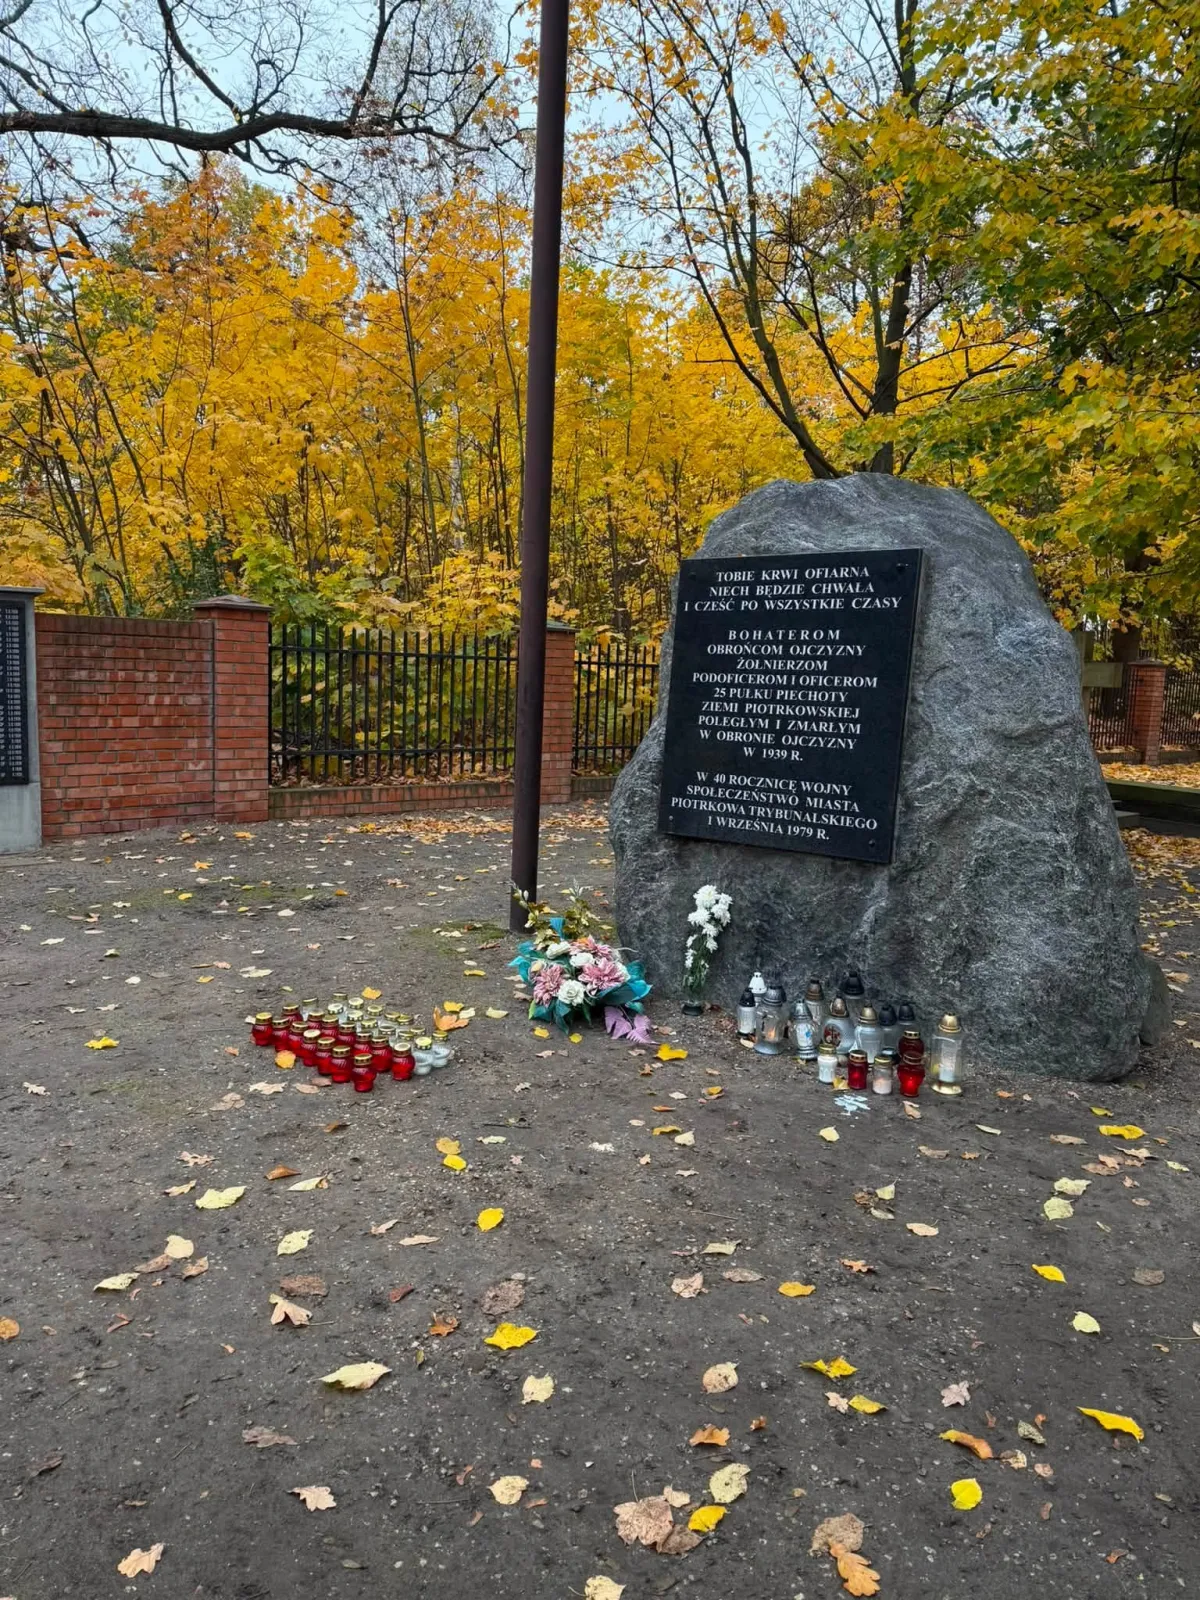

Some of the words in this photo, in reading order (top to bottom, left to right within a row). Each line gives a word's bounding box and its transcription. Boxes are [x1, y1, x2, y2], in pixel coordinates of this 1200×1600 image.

[716, 570, 755, 582] TOBIE
[761, 569, 798, 580] KRWI
[805, 566, 870, 579] OFIARNA
[709, 585, 750, 597] NIECH
[756, 584, 805, 599] BĘDZIE
[811, 582, 875, 594] CHWAŁA
[684, 602, 689, 612] I
[694, 598, 735, 611] CZEŚĆ
[741, 600, 759, 611] PO
[765, 598, 845, 610] WSZYSTKIE
[851, 597, 901, 609] CZASY
[707, 642, 783, 656] OBROŃCOM
[790, 645, 866, 656] OJCZYZNY
[736, 658, 828, 671] ŻOŁNIERZOM
[692, 673, 787, 686] PODOFICEROM
[791, 675, 796, 685] I
[800, 675, 878, 688] OFICEROM
[713, 687, 726, 698] 25
[729, 688, 773, 700] PUŁKU
[776, 690, 849, 702] PIECHOTY
[701, 701, 738, 713] ZIEMI
[745, 703, 860, 719] PIOTRKOWSKIEJ
[698, 715, 769, 729] POLEGŁYM
[775, 719, 780, 730] I
[787, 720, 861, 734] ZMARŁYM
[699, 730, 712, 740] W
[717, 730, 776, 744] OBRONIE
[781, 735, 857, 750] OJCZYZNY
[743, 747, 756, 758] W
[762, 748, 787, 760] 1939
[790, 751, 803, 762] R.
[696, 772, 709, 782] W
[713, 773, 726, 784] 40
[728, 776, 797, 792] ROCZNICĘ
[800, 781, 853, 796] WOJNY
[686, 785, 799, 806] SPOŁECZEŃSTWO
[805, 797, 860, 813] MIASTA
[671, 797, 745, 815] PIOTRKOWA
[749, 805, 878, 831] TRYBUNALSKIEGO
[716, 816, 784, 835] WRZEŚNIA
[787, 825, 814, 838] 1979
[817, 829, 830, 840] R.
